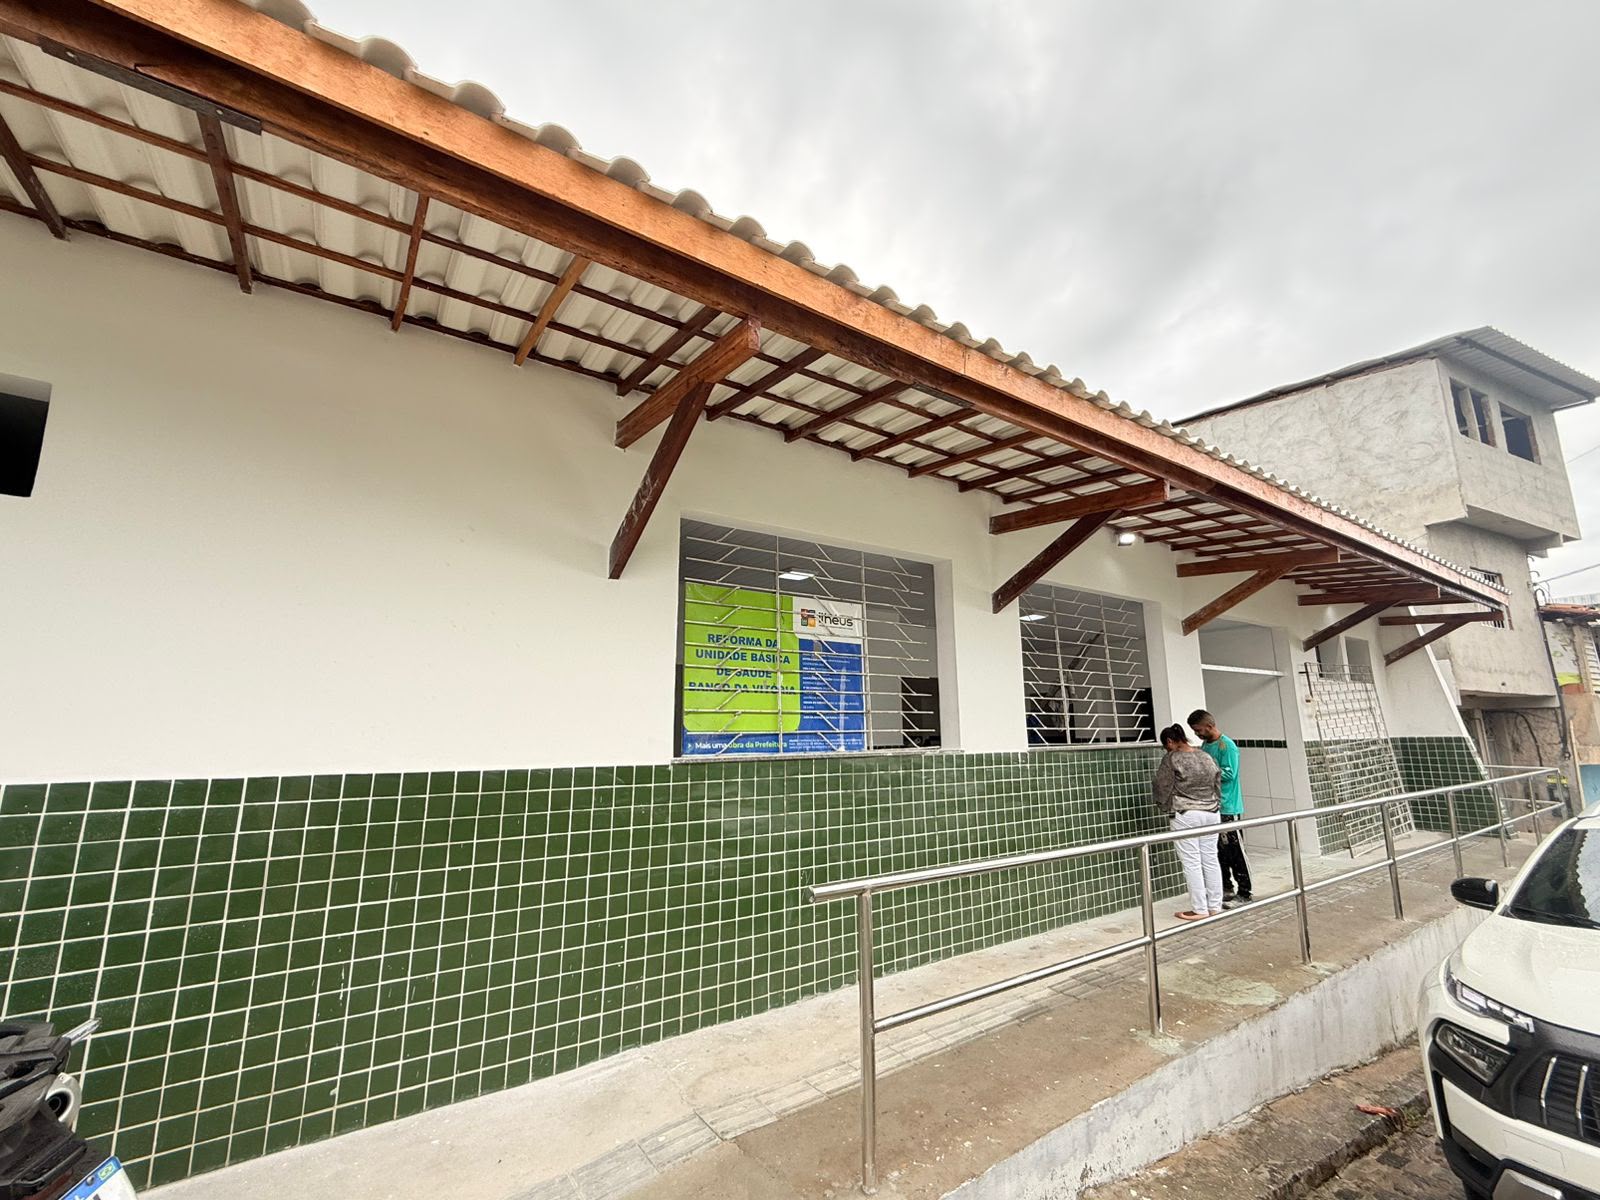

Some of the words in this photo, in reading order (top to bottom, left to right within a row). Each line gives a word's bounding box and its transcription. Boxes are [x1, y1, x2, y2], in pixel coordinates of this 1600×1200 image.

[707, 633, 763, 647] REFORMA
[765, 638, 780, 648] DA
[695, 648, 748, 661] UNIDADE
[750, 651, 791, 664] BÁSICA
[716, 667, 732, 676] DE
[736, 666, 773, 679] SAÚDE
